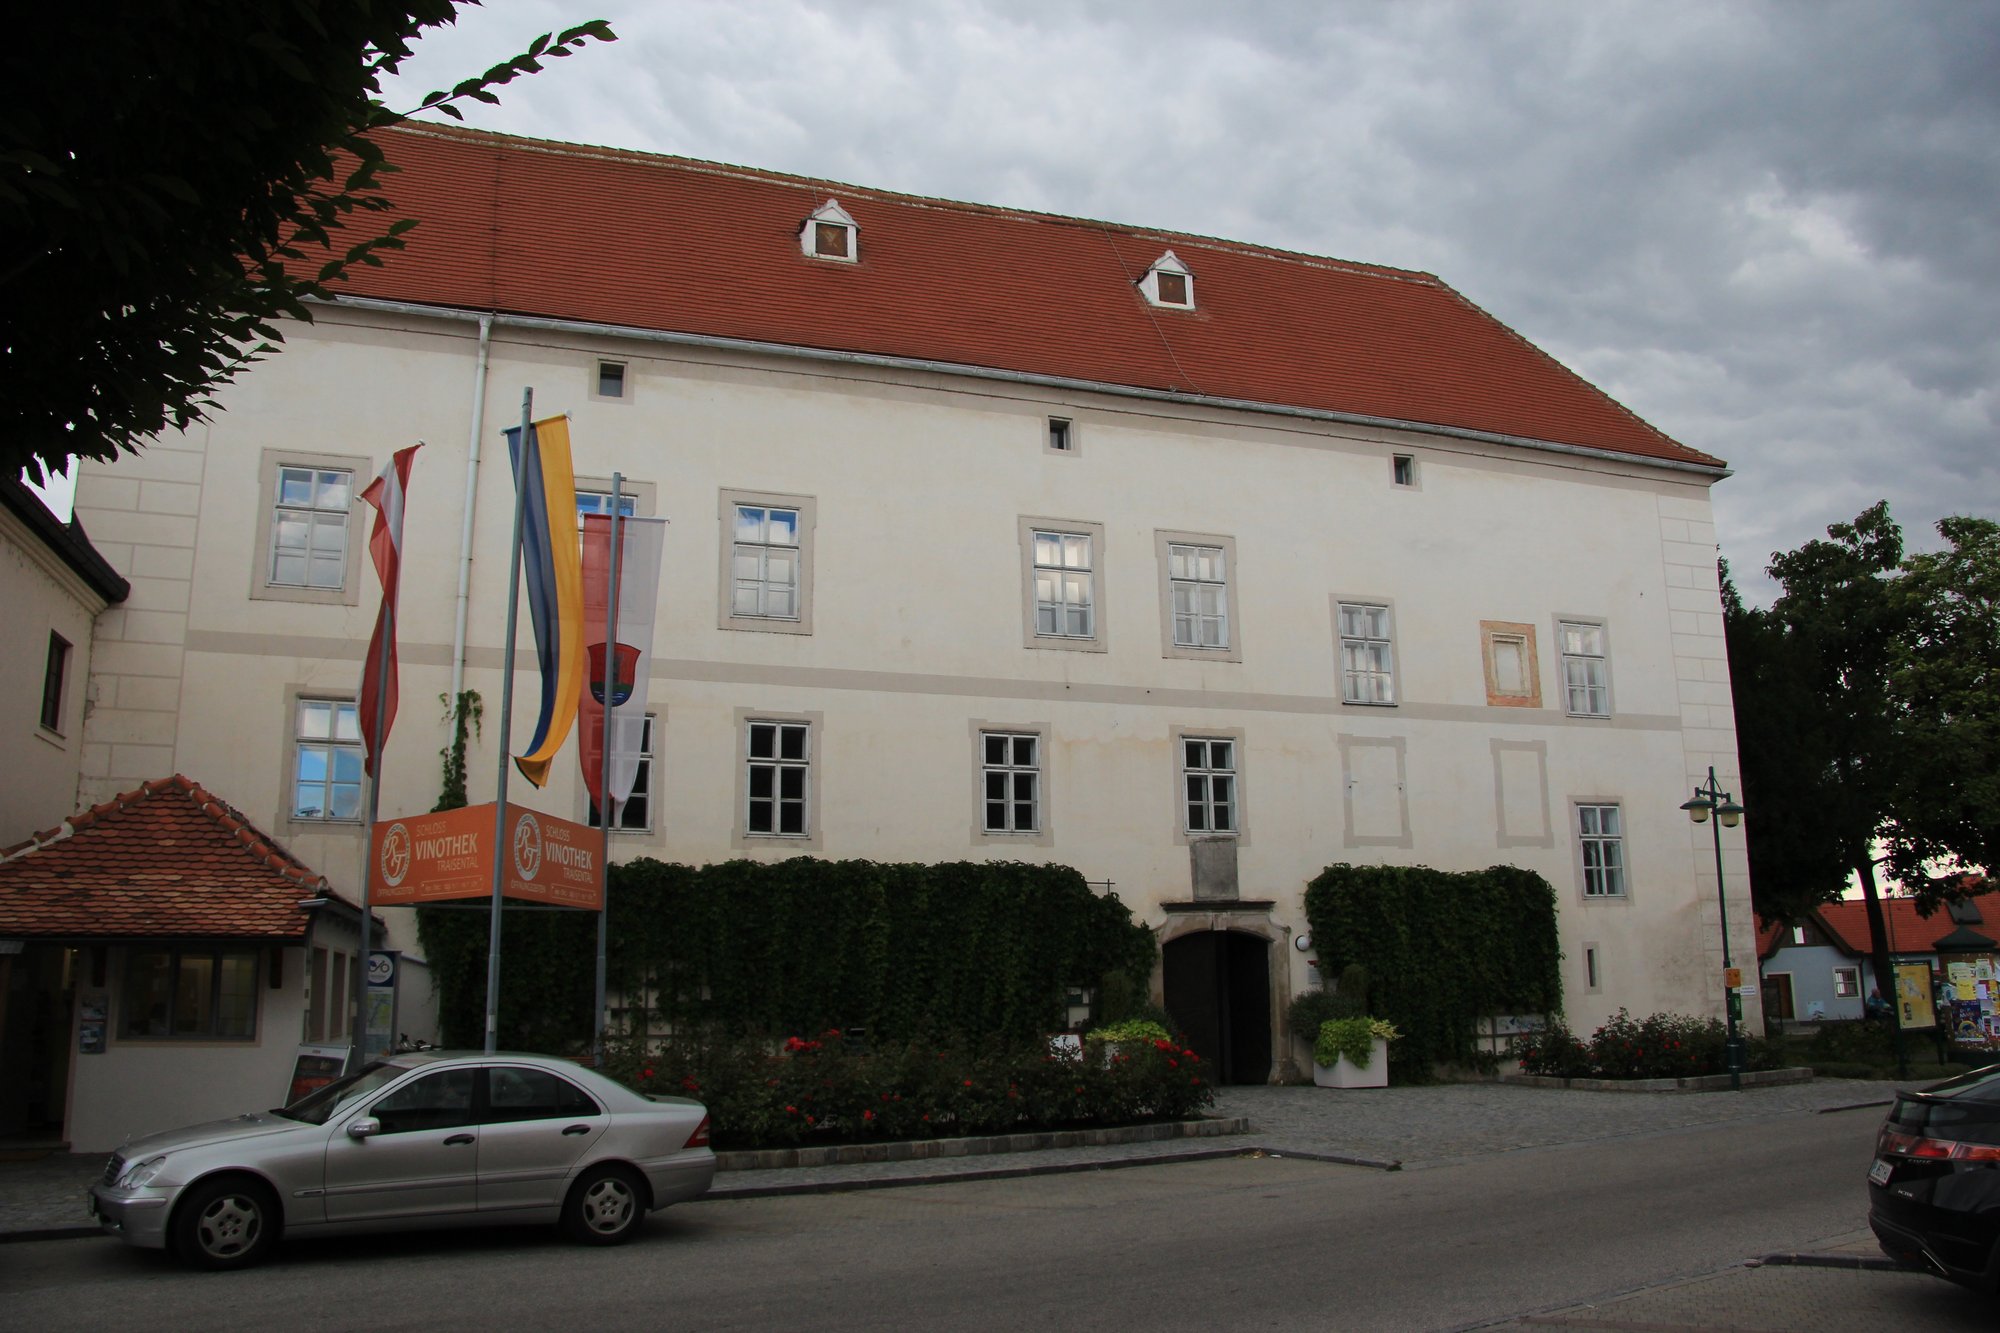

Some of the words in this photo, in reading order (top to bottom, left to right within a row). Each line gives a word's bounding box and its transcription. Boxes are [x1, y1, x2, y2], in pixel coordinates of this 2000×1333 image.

[416, 821, 447, 837] SCHLOSS
[545, 825, 570, 841] SCHLOSS
[415, 833, 478, 860] VINOTHEK
[545, 841, 593, 870] VINOTHEK
[437, 857, 479, 872] TRAISENTAL
[563, 867, 593, 884] TRAISENTAL
